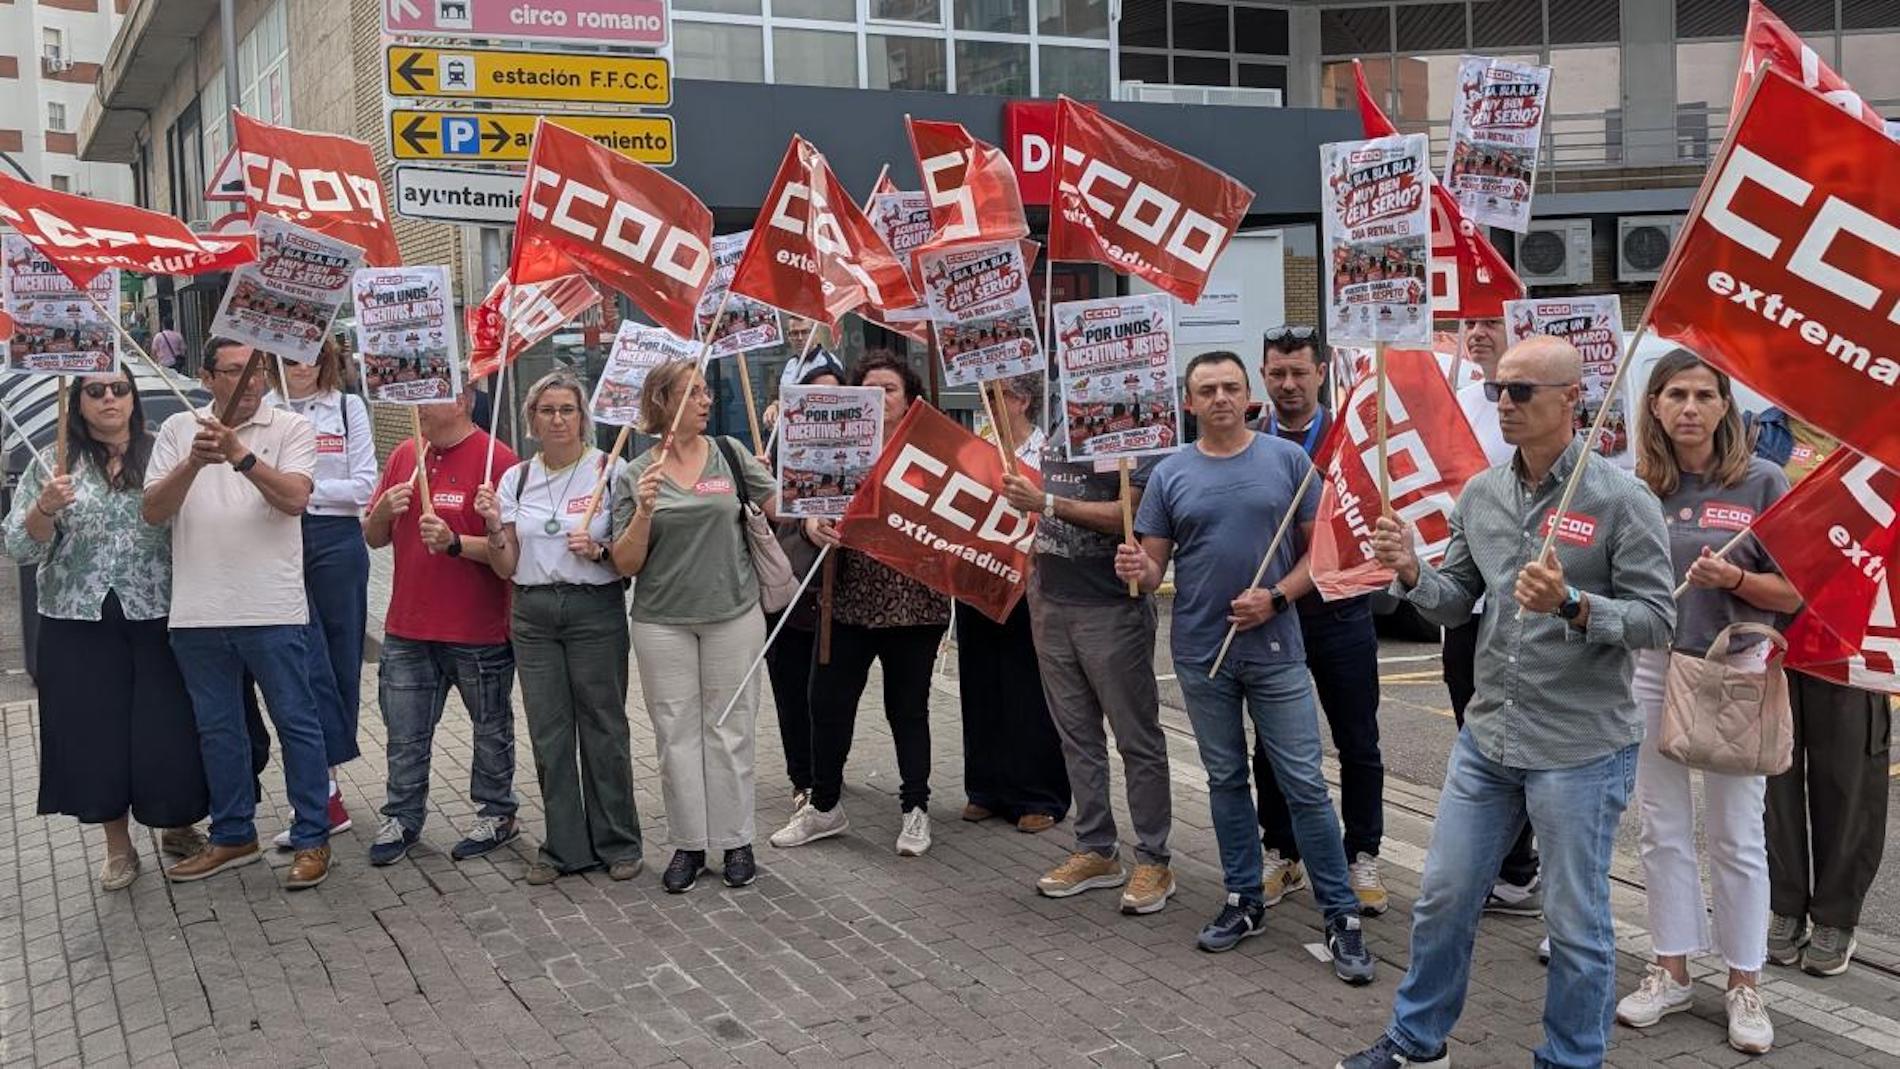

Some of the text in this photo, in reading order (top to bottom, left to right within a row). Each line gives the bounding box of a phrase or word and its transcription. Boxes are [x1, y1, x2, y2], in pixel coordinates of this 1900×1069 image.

[510, 6, 661, 31] circo romano
[492, 69, 664, 90] estación F.F.C.C.
[1494, 106, 1540, 124] SERIO?
[515, 131, 667, 151] amiento
[1022, 134, 1051, 172] D
[404, 186, 523, 208] ayuntamie
[1371, 184, 1421, 217] SERIO?
[1701, 144, 1900, 330] CC
[974, 271, 1019, 299] SERIO?
[1084, 308, 1120, 320] CCOO
[1086, 319, 1151, 344] POR UNOS
[1573, 330, 1610, 346] MARCO
[1067, 340, 1129, 369] INCENTIVOS
[805, 407, 862, 421] POR UNOS
[1705, 507, 1752, 524] CCOO
